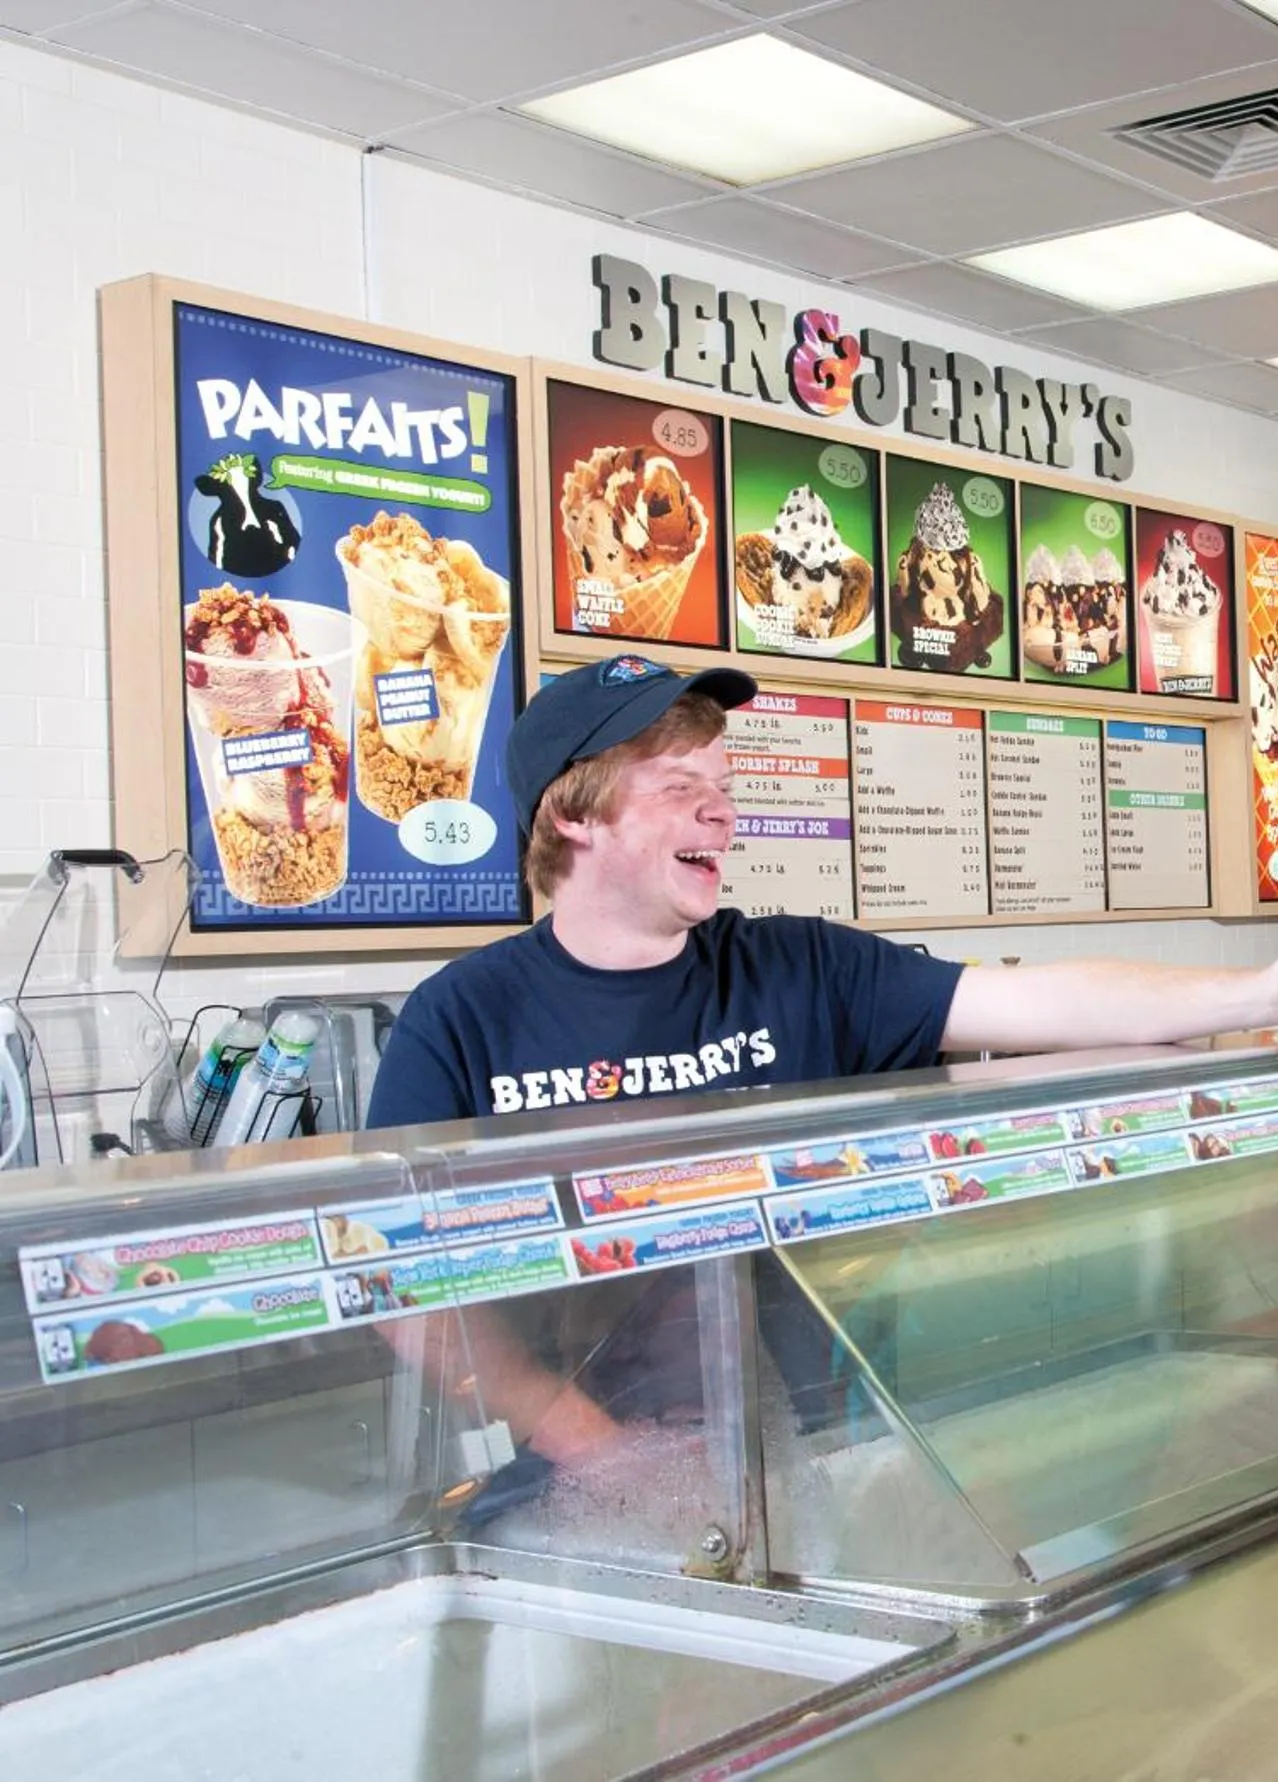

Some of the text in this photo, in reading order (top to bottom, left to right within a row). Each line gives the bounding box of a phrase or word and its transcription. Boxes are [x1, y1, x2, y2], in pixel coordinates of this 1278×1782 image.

[197, 378, 490, 474] PARFAITS!
[661, 422, 697, 449] 4.85
[826, 458, 861, 483] 5.50
[969, 487, 999, 511] 5.50
[578, 595, 625, 614] WAFFLE
[578, 610, 611, 628] CONE
[752, 696, 797, 712] SHAKES
[885, 706, 911, 721] CUPS
[732, 756, 819, 775] SORBET SPLASH
[424, 821, 472, 845] 5.43
[735, 819, 829, 835] EN & JERRY'S JOE
